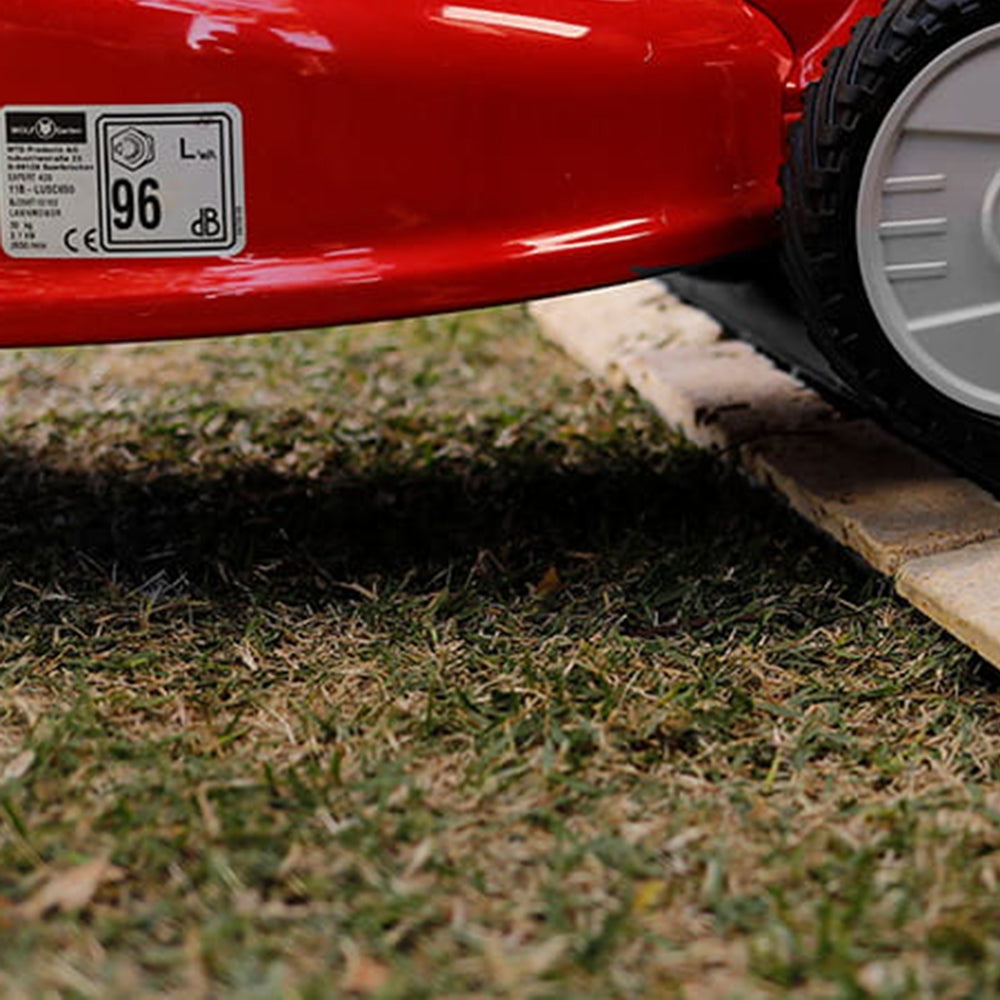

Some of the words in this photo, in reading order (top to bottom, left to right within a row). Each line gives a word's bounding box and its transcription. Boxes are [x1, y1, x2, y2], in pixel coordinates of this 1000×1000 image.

[111, 178, 162, 230] 96
[190, 207, 221, 236] dB
[63, 227, 99, 254] CE
